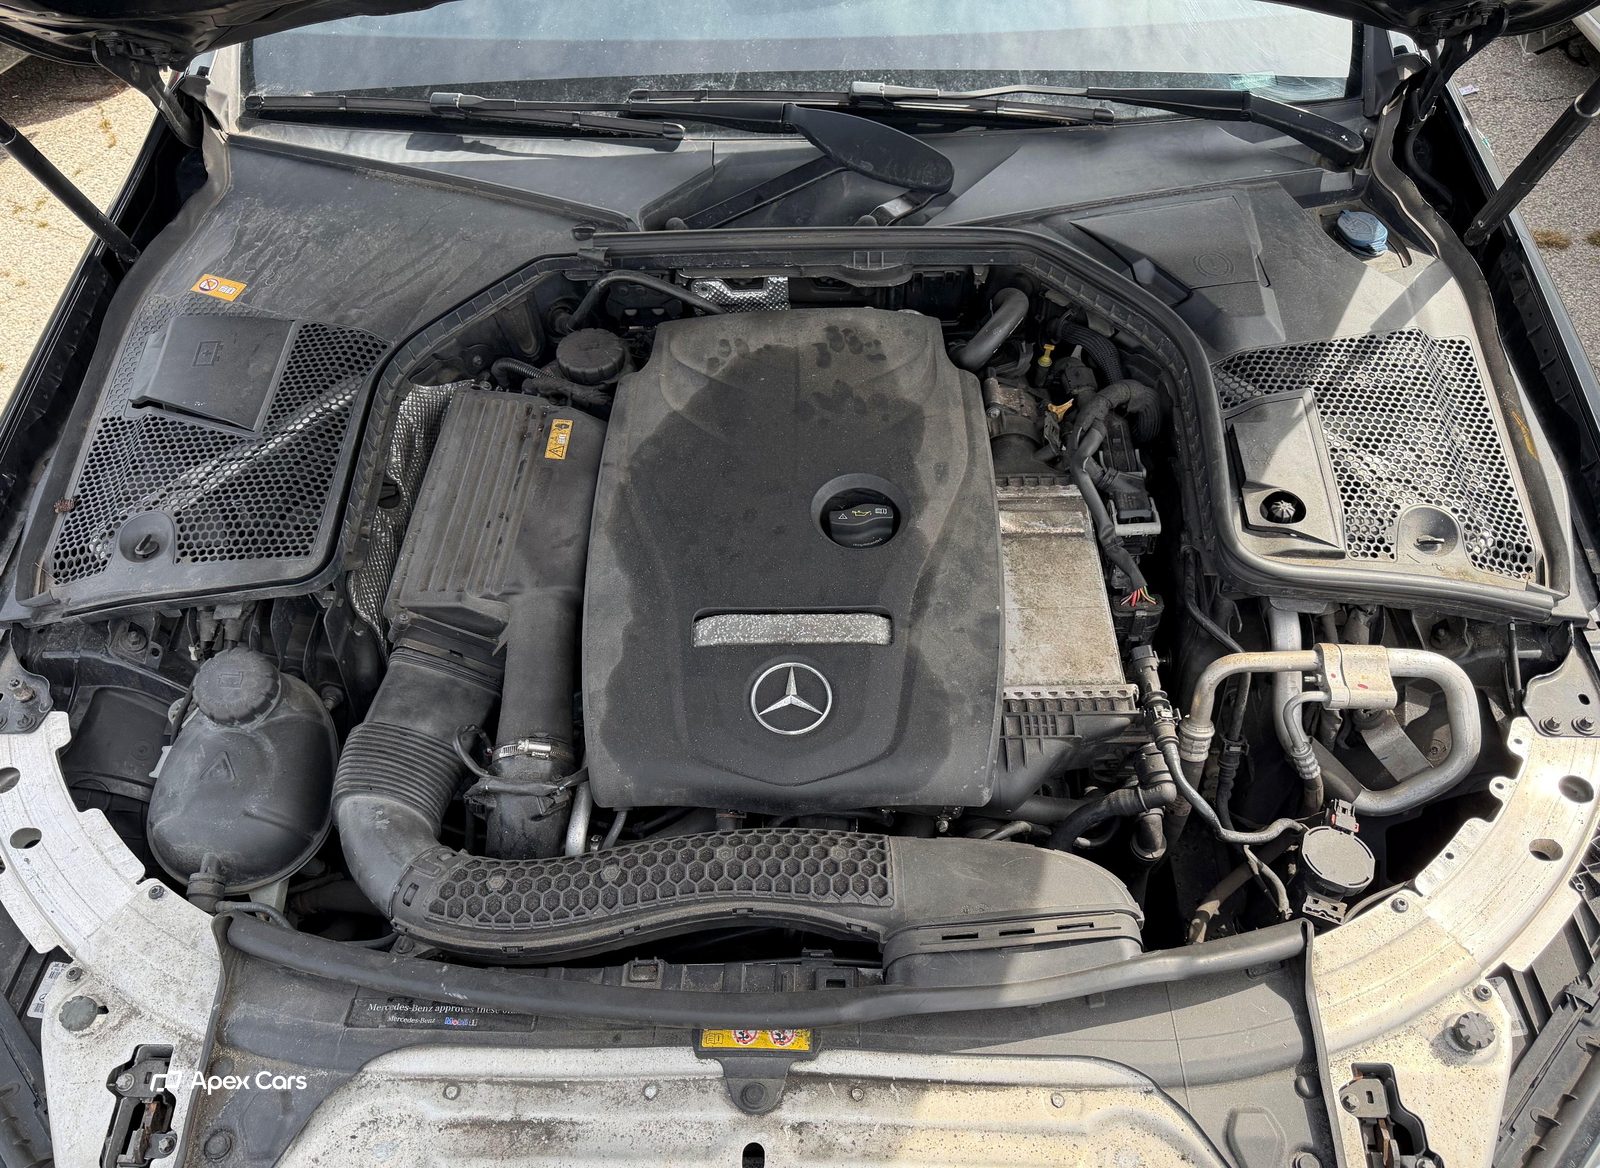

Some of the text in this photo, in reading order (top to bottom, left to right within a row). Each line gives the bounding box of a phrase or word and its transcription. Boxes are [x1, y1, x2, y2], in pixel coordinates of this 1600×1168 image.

[367, 1003, 433, 1012] Mercedes-Benz
[434, 1004, 474, 1014] approves
[387, 1015, 436, 1024] Mercedes-Benz
[444, 1017, 469, 1026] Mobil
